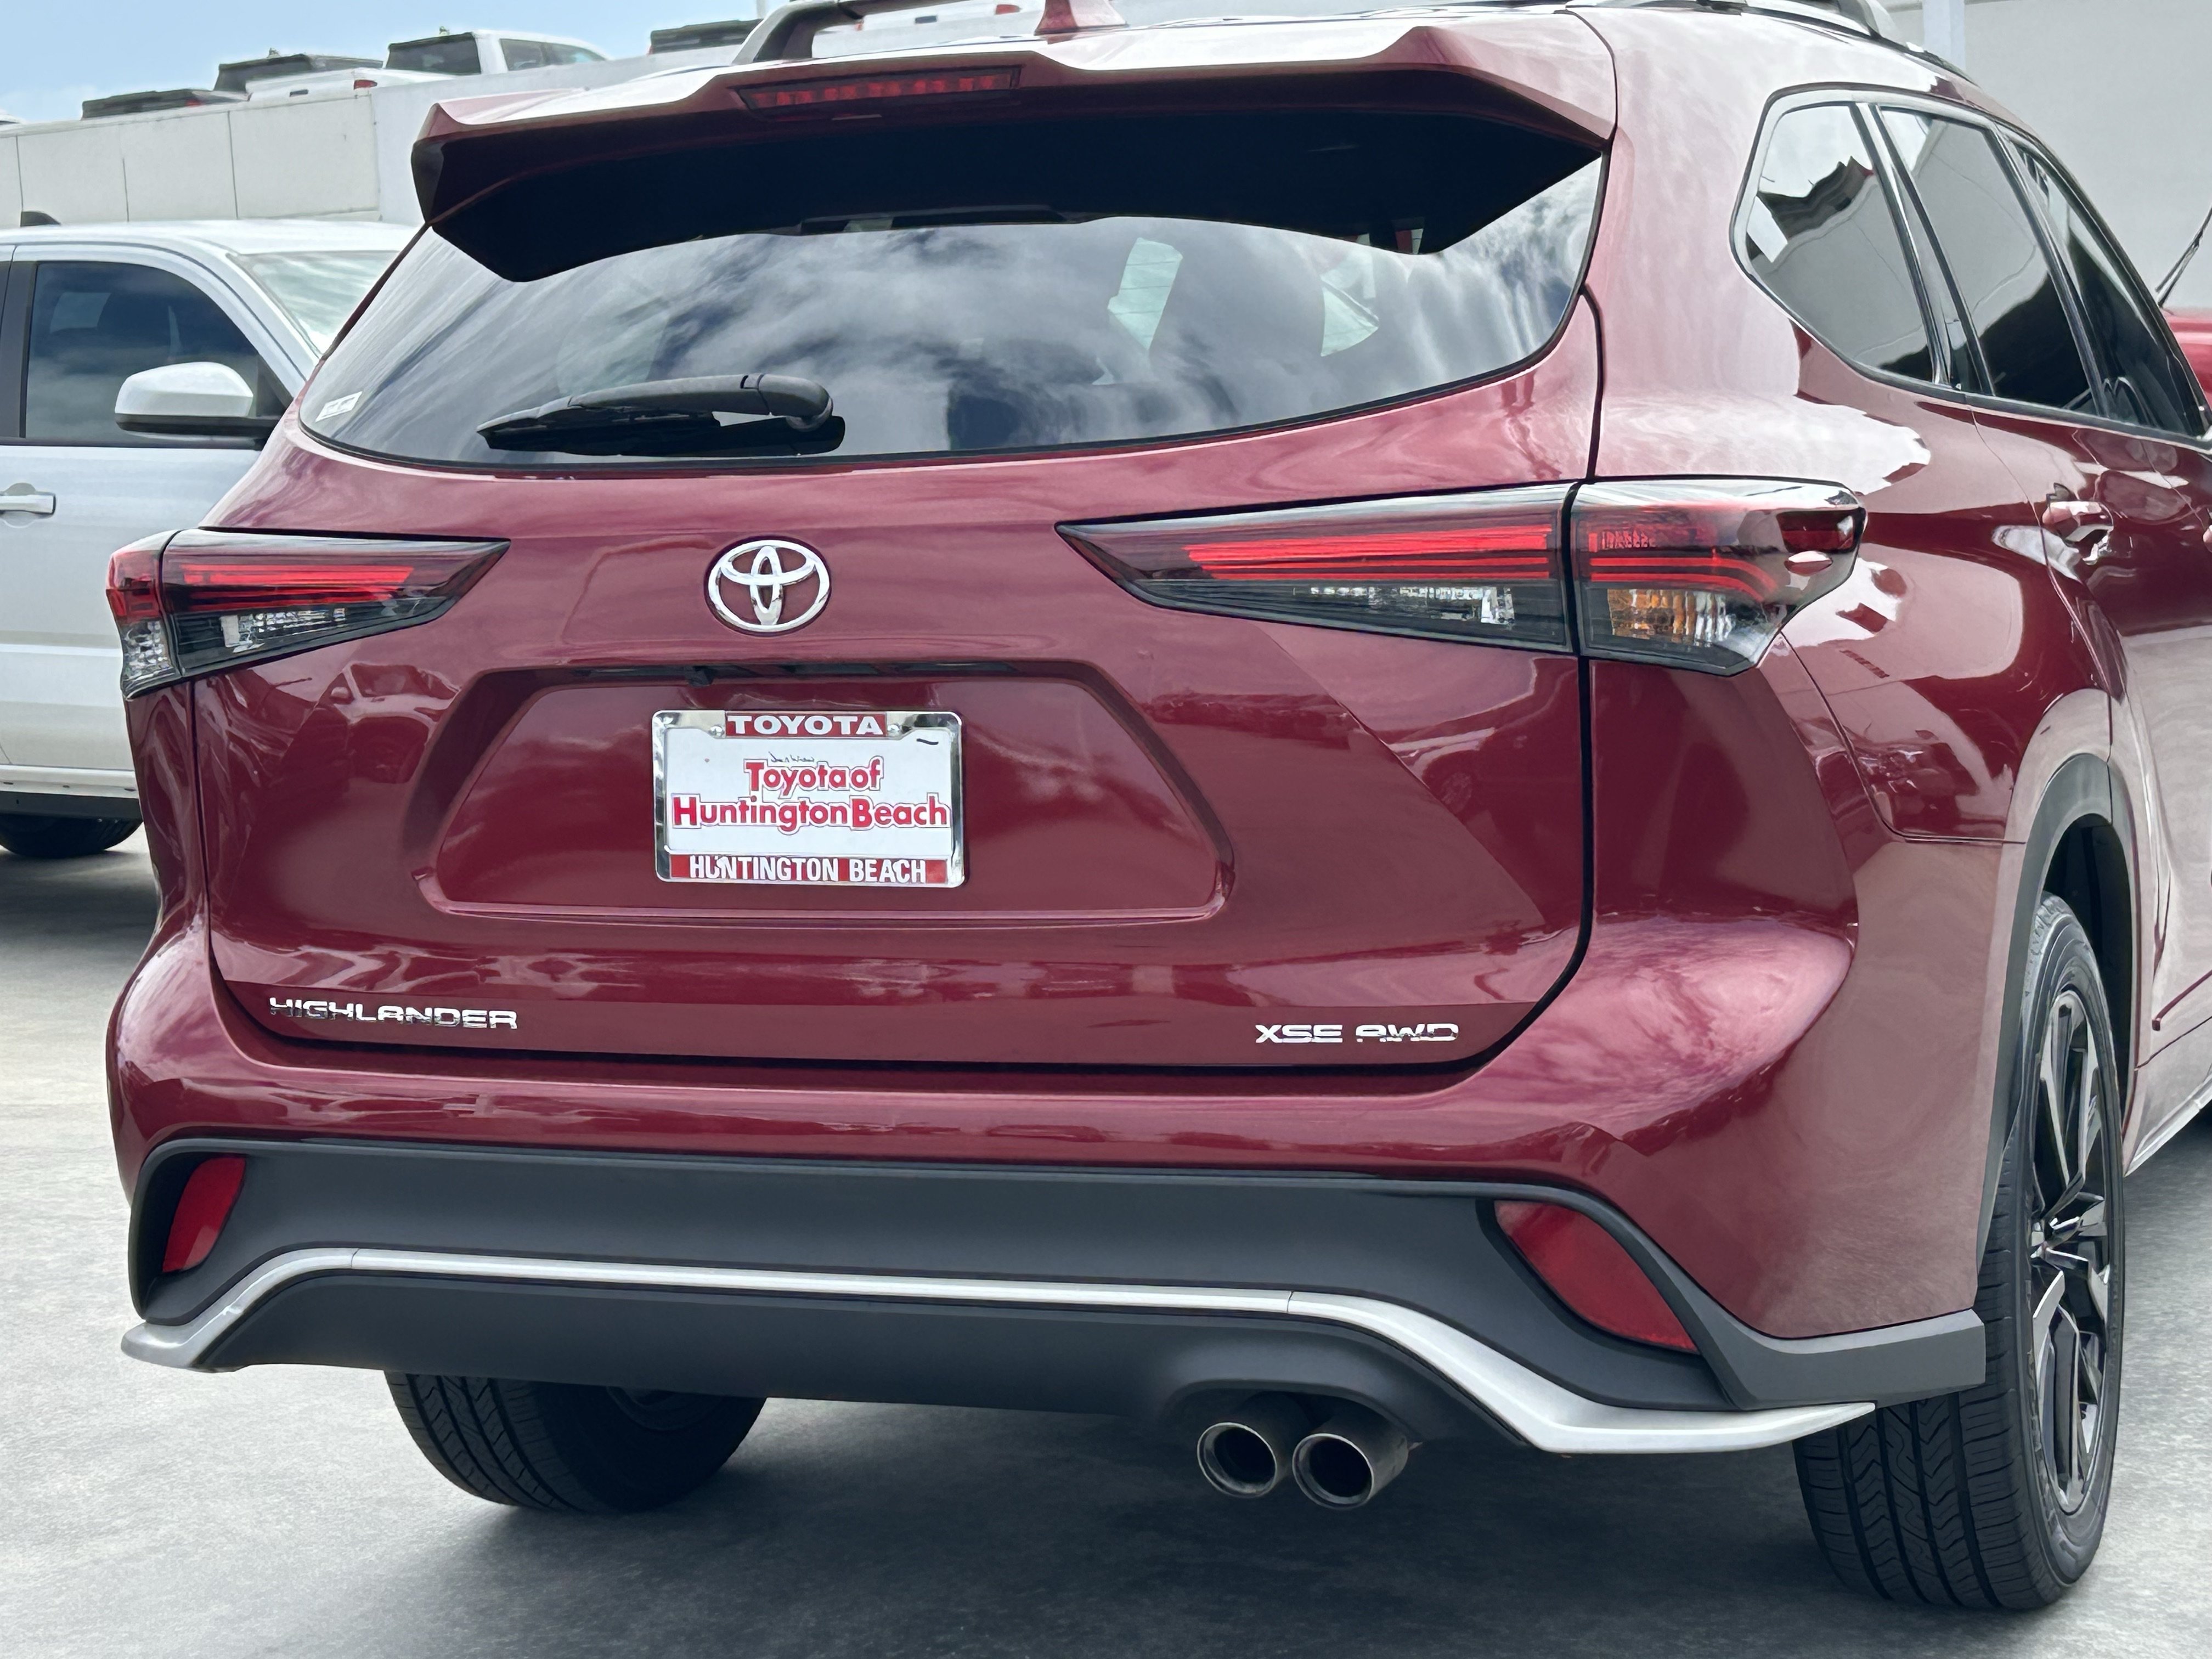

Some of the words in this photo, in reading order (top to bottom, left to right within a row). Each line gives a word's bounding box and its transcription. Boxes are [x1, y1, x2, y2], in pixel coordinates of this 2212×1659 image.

[727, 715, 883, 734] TOYOTA
[746, 762, 847, 795] Toyota
[851, 759, 881, 788] of
[673, 796, 847, 831] Huntington
[851, 796, 947, 827] Beach
[690, 856, 839, 881] HUNTINGTON
[849, 859, 926, 883] BEACH
[269, 997, 517, 1029] HIGHLANDER
[1255, 1024, 1343, 1043] XSE
[1356, 1023, 1459, 1042] AWD
